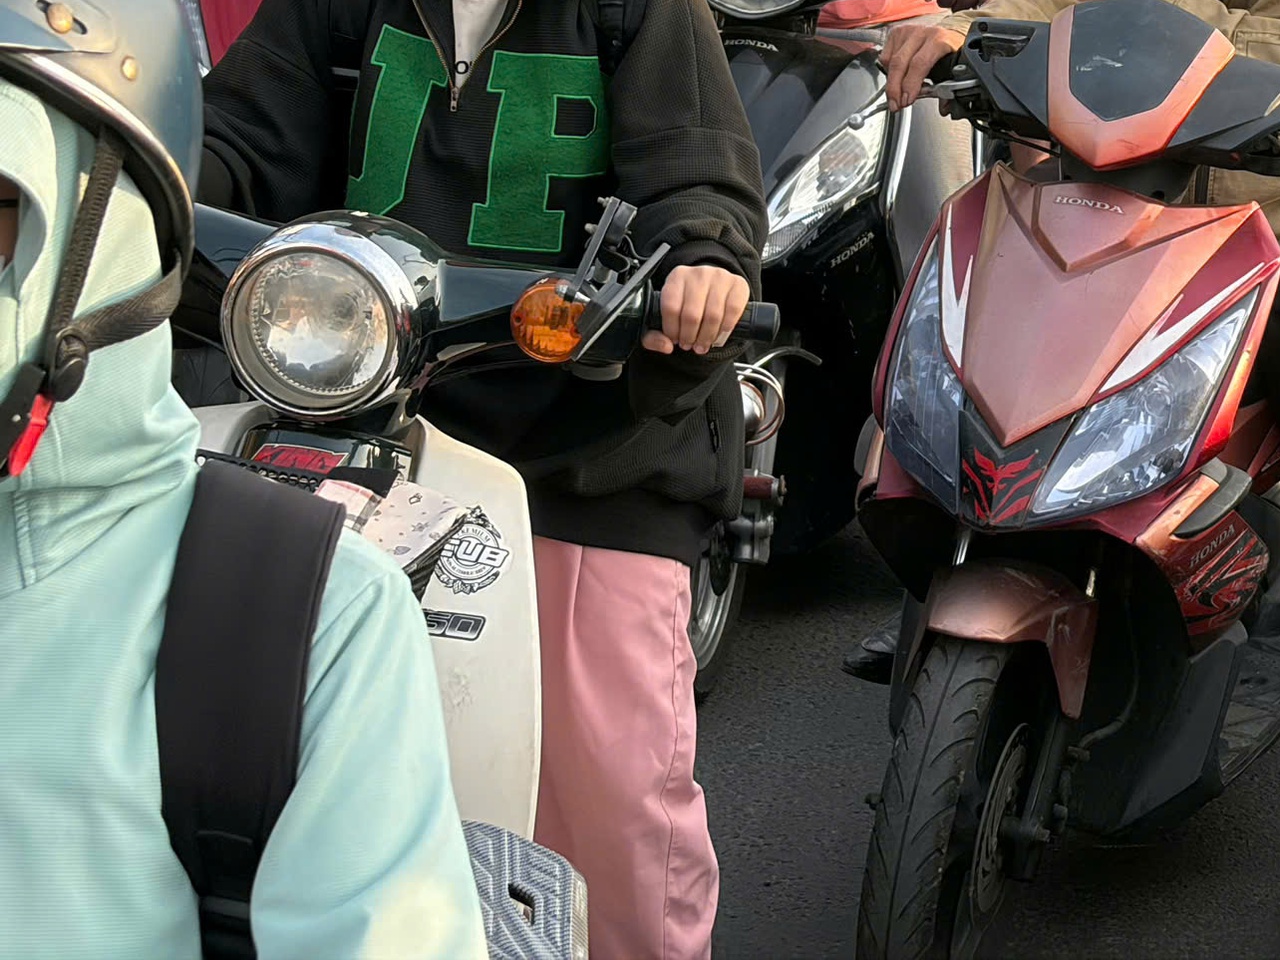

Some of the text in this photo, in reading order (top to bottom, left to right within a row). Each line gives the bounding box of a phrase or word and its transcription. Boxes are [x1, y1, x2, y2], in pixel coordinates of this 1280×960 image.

[724, 38, 779, 53] HONDA
[1054, 194, 1126, 215] HONDA
[830, 230, 875, 269] HONDA
[1190, 524, 1236, 568] HONDA
